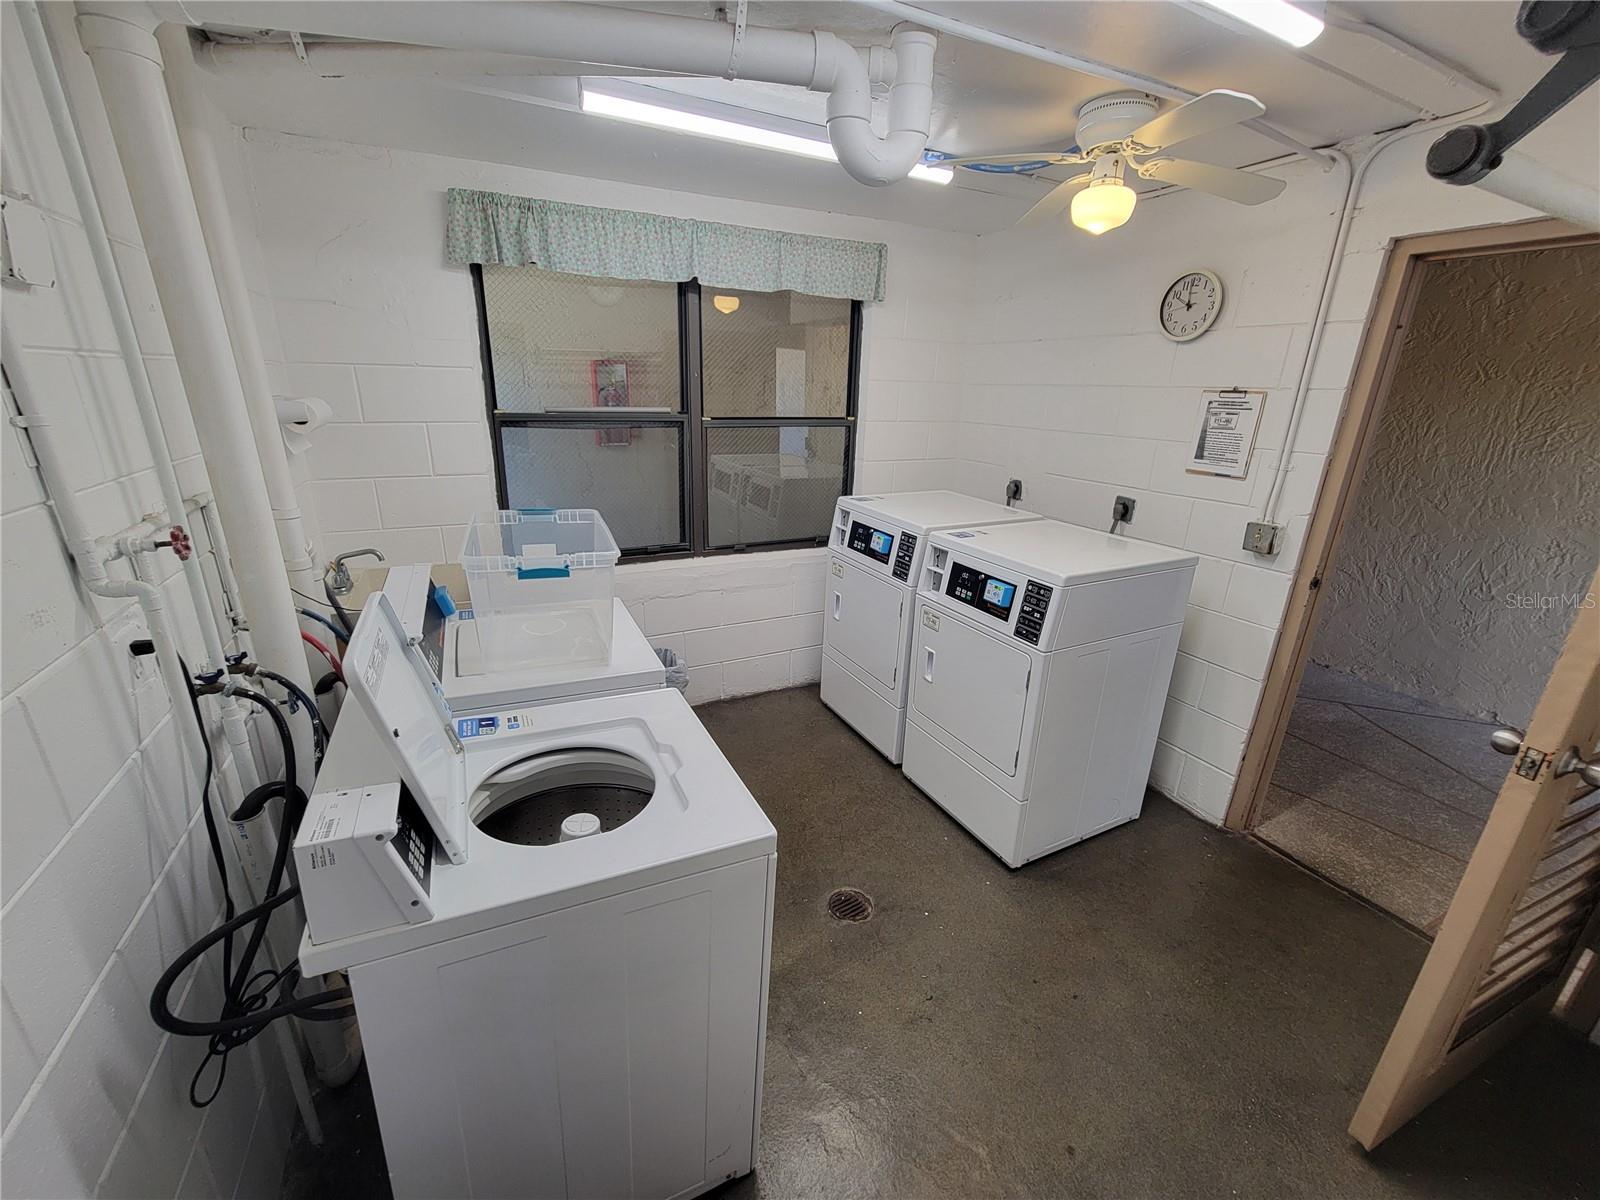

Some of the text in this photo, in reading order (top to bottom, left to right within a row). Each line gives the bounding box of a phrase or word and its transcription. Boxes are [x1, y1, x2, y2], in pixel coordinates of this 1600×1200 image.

[1182, 281, 1190, 291] 11
[1191, 277, 1202, 287] 12
[1203, 279, 1209, 290] 1
[1172, 290, 1182, 300] 10
[1207, 287, 1215, 298] 2
[1166, 300, 1173, 310] 9
[1208, 300, 1216, 311] 3
[1166, 312, 1173, 322] 8
[1200, 312, 1208, 323] 4
[1172, 320, 1179, 331] 7
[1180, 323, 1187, 334] 6
[1191, 320, 1199, 331] 5
